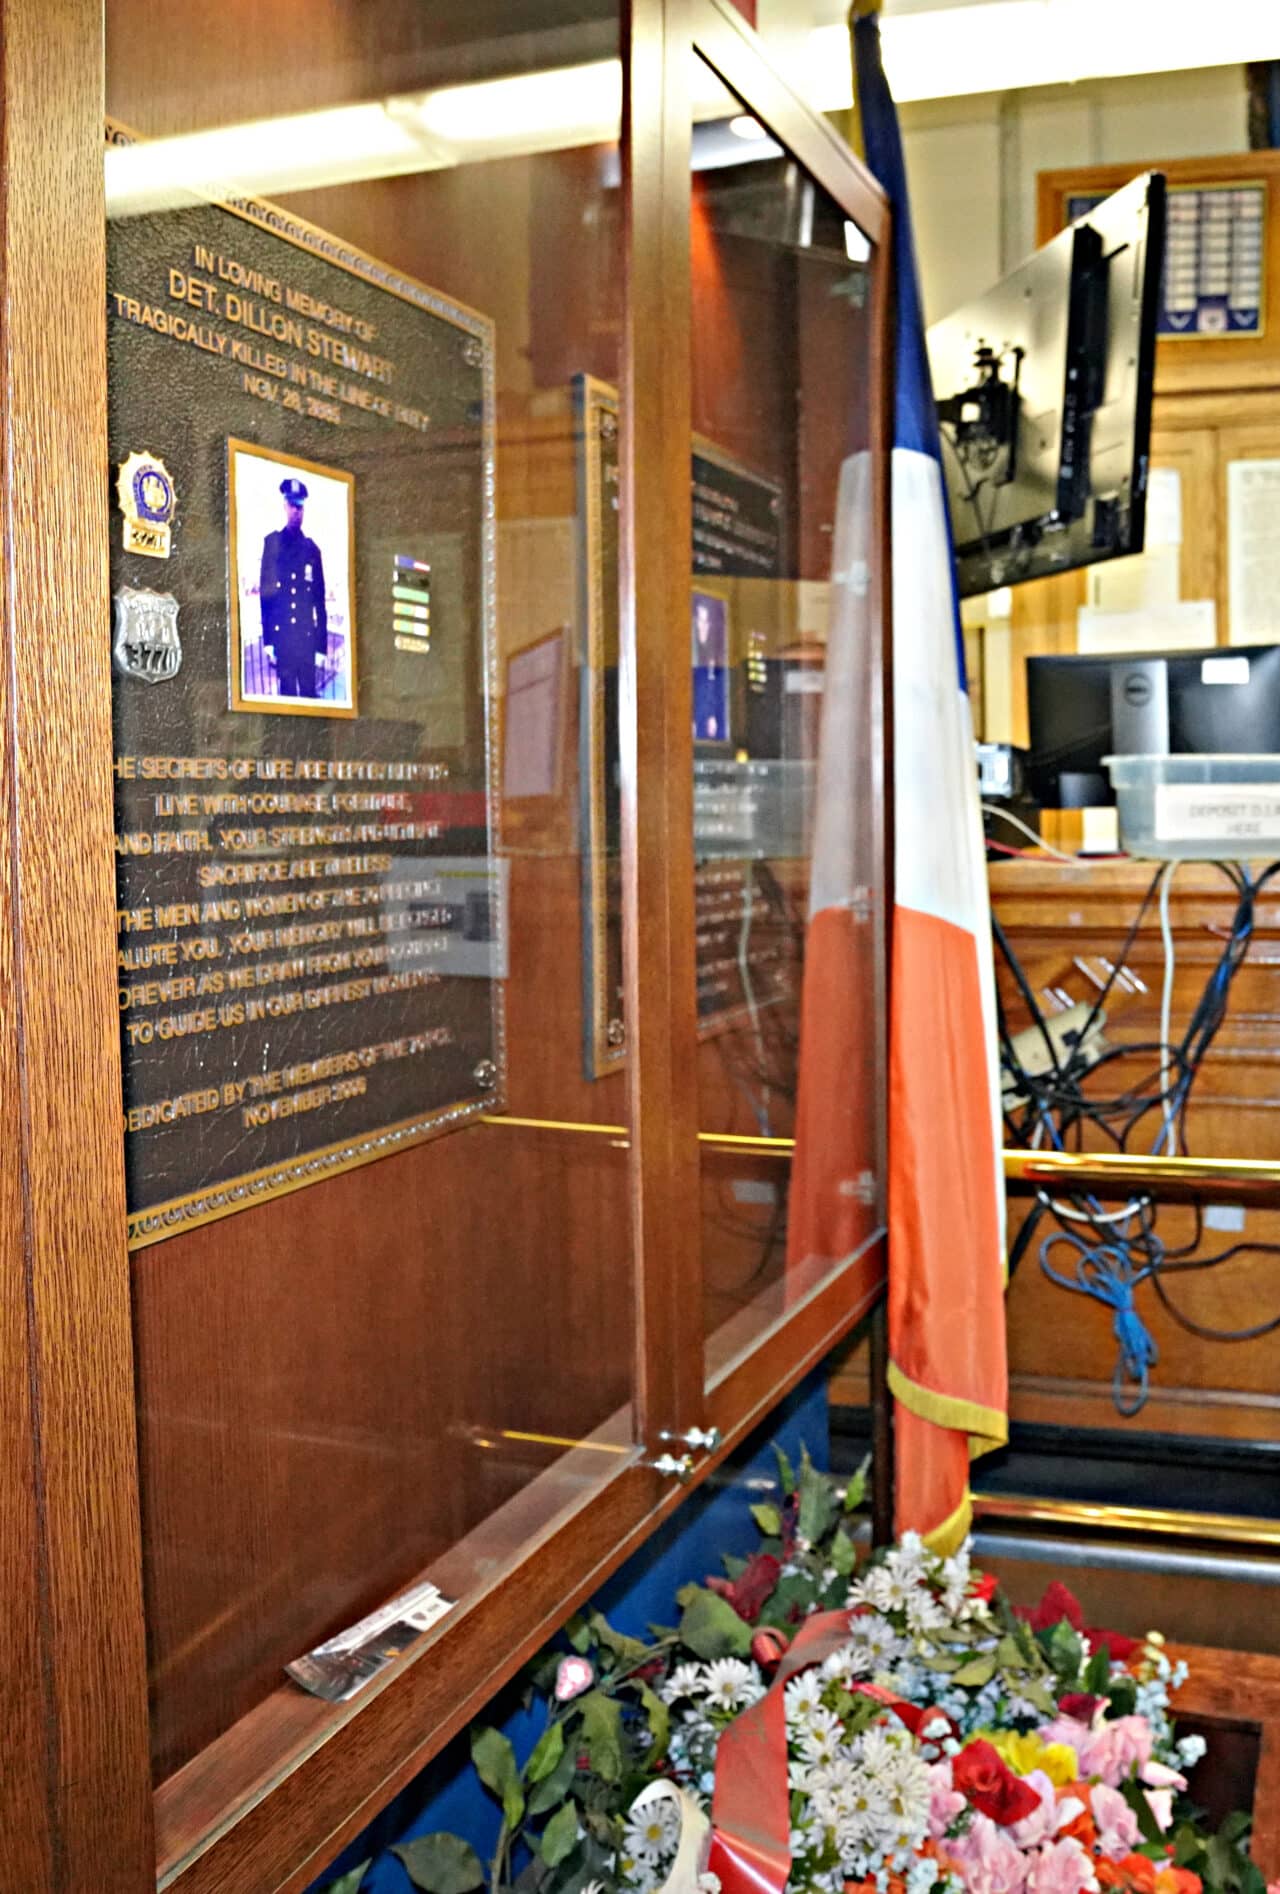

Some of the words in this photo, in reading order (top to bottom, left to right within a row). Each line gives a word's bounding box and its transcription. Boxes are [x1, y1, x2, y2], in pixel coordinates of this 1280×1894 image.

[194, 244, 214, 273] IN
[218, 256, 282, 303] LOVING
[286, 288, 352, 334] MEMORY
[354, 318, 378, 342] OF
[113, 293, 227, 353] TRAGICALLY
[232, 339, 288, 378] KILLED
[308, 368, 338, 396] THE
[226, 293, 303, 349] DILLON
[307, 329, 397, 385] STEWART
[141, 757, 228, 780] SECRETS
[232, 758, 255, 780] OF
[256, 758, 293, 781] LIFE
[155, 793, 199, 816] LIVE
[203, 793, 248, 815] WITH
[220, 827, 267, 849] YOUR
[200, 860, 288, 888] SACRIFICE
[117, 908, 152, 933] THE
[155, 902, 199, 928] MEN
[201, 898, 240, 922] AND
[244, 890, 306, 918] WOMEN
[118, 943, 177, 970] ALUTE
[226, 930, 274, 954] YOUR
[119, 977, 195, 1010] OREVER
[198, 970, 224, 995] AS
[229, 966, 255, 989] WE
[127, 1021, 153, 1046] TO
[158, 1008, 217, 1040] GUIDE
[219, 1003, 244, 1027] US
[246, 998, 265, 1021] IN
[267, 991, 303, 1017] OUR
[223, 1081, 246, 1106] BY
[248, 1070, 281, 1097] THE
[283, 1050, 359, 1088] MEMBERS
[243, 1084, 331, 1128] NOVEMBER
